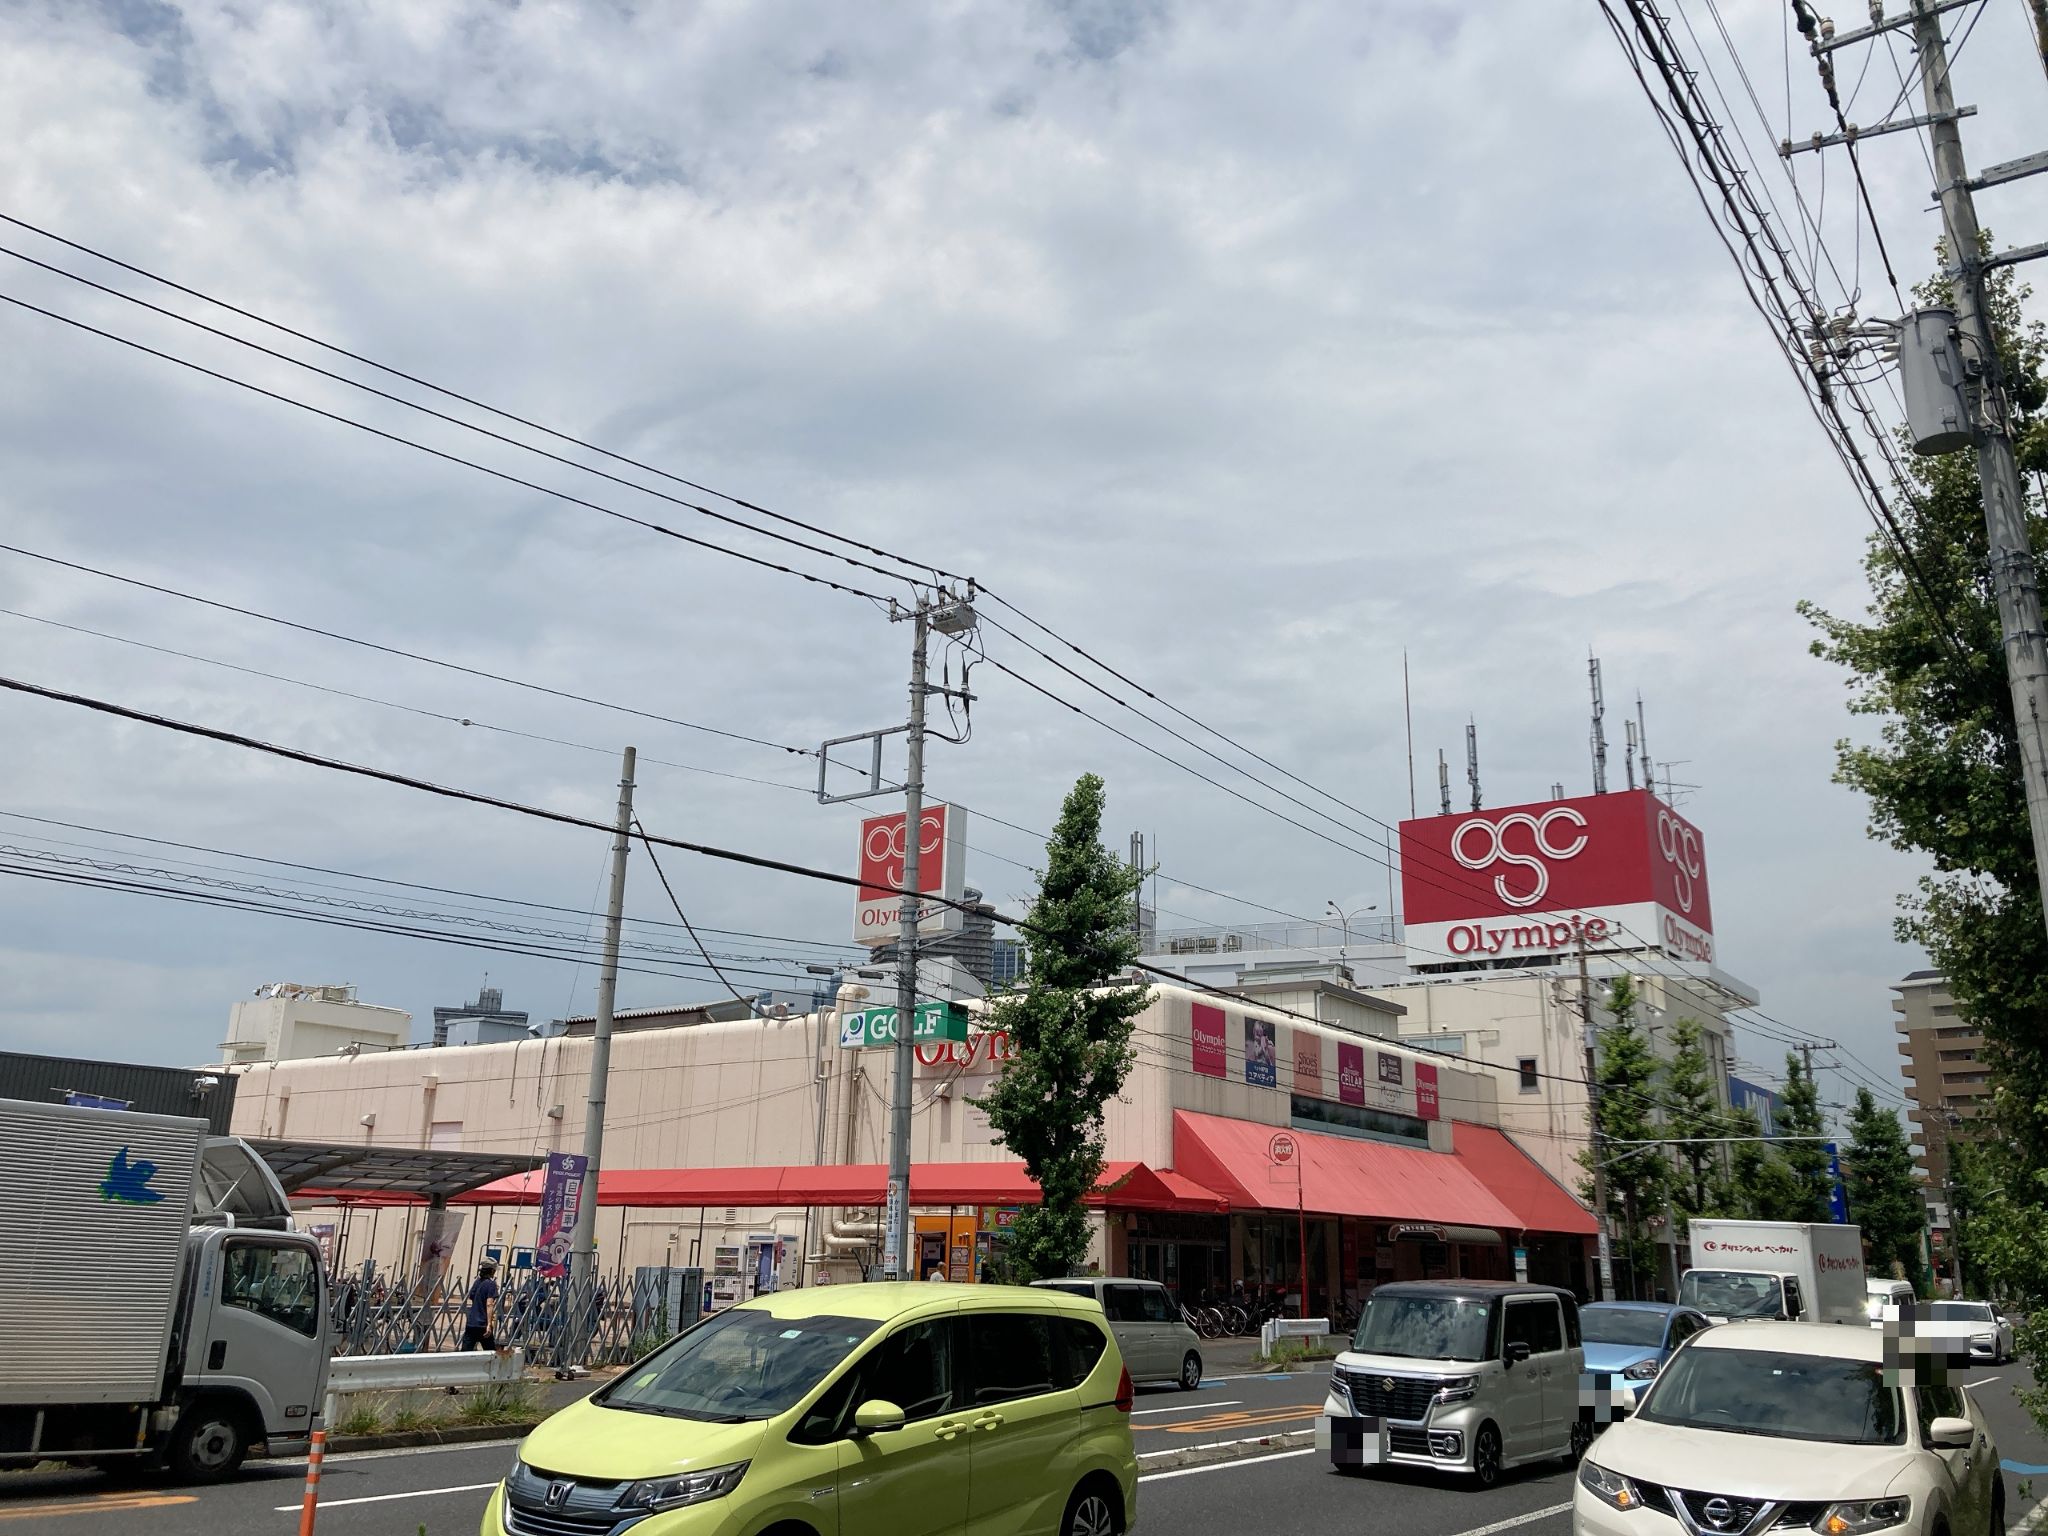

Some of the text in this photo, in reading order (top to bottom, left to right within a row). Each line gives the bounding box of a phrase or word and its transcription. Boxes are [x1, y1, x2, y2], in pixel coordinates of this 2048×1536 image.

[1446, 915, 1608, 955] Olympic
[1664, 914, 1712, 963] Olympic
[1193, 1029, 1225, 1047] Olympic
[1340, 1073, 1363, 1088] CELLAR
[563, 1182, 578, 1226] 自転車
[1720, 1243, 1799, 1254] オリエンタル ベーカリー
